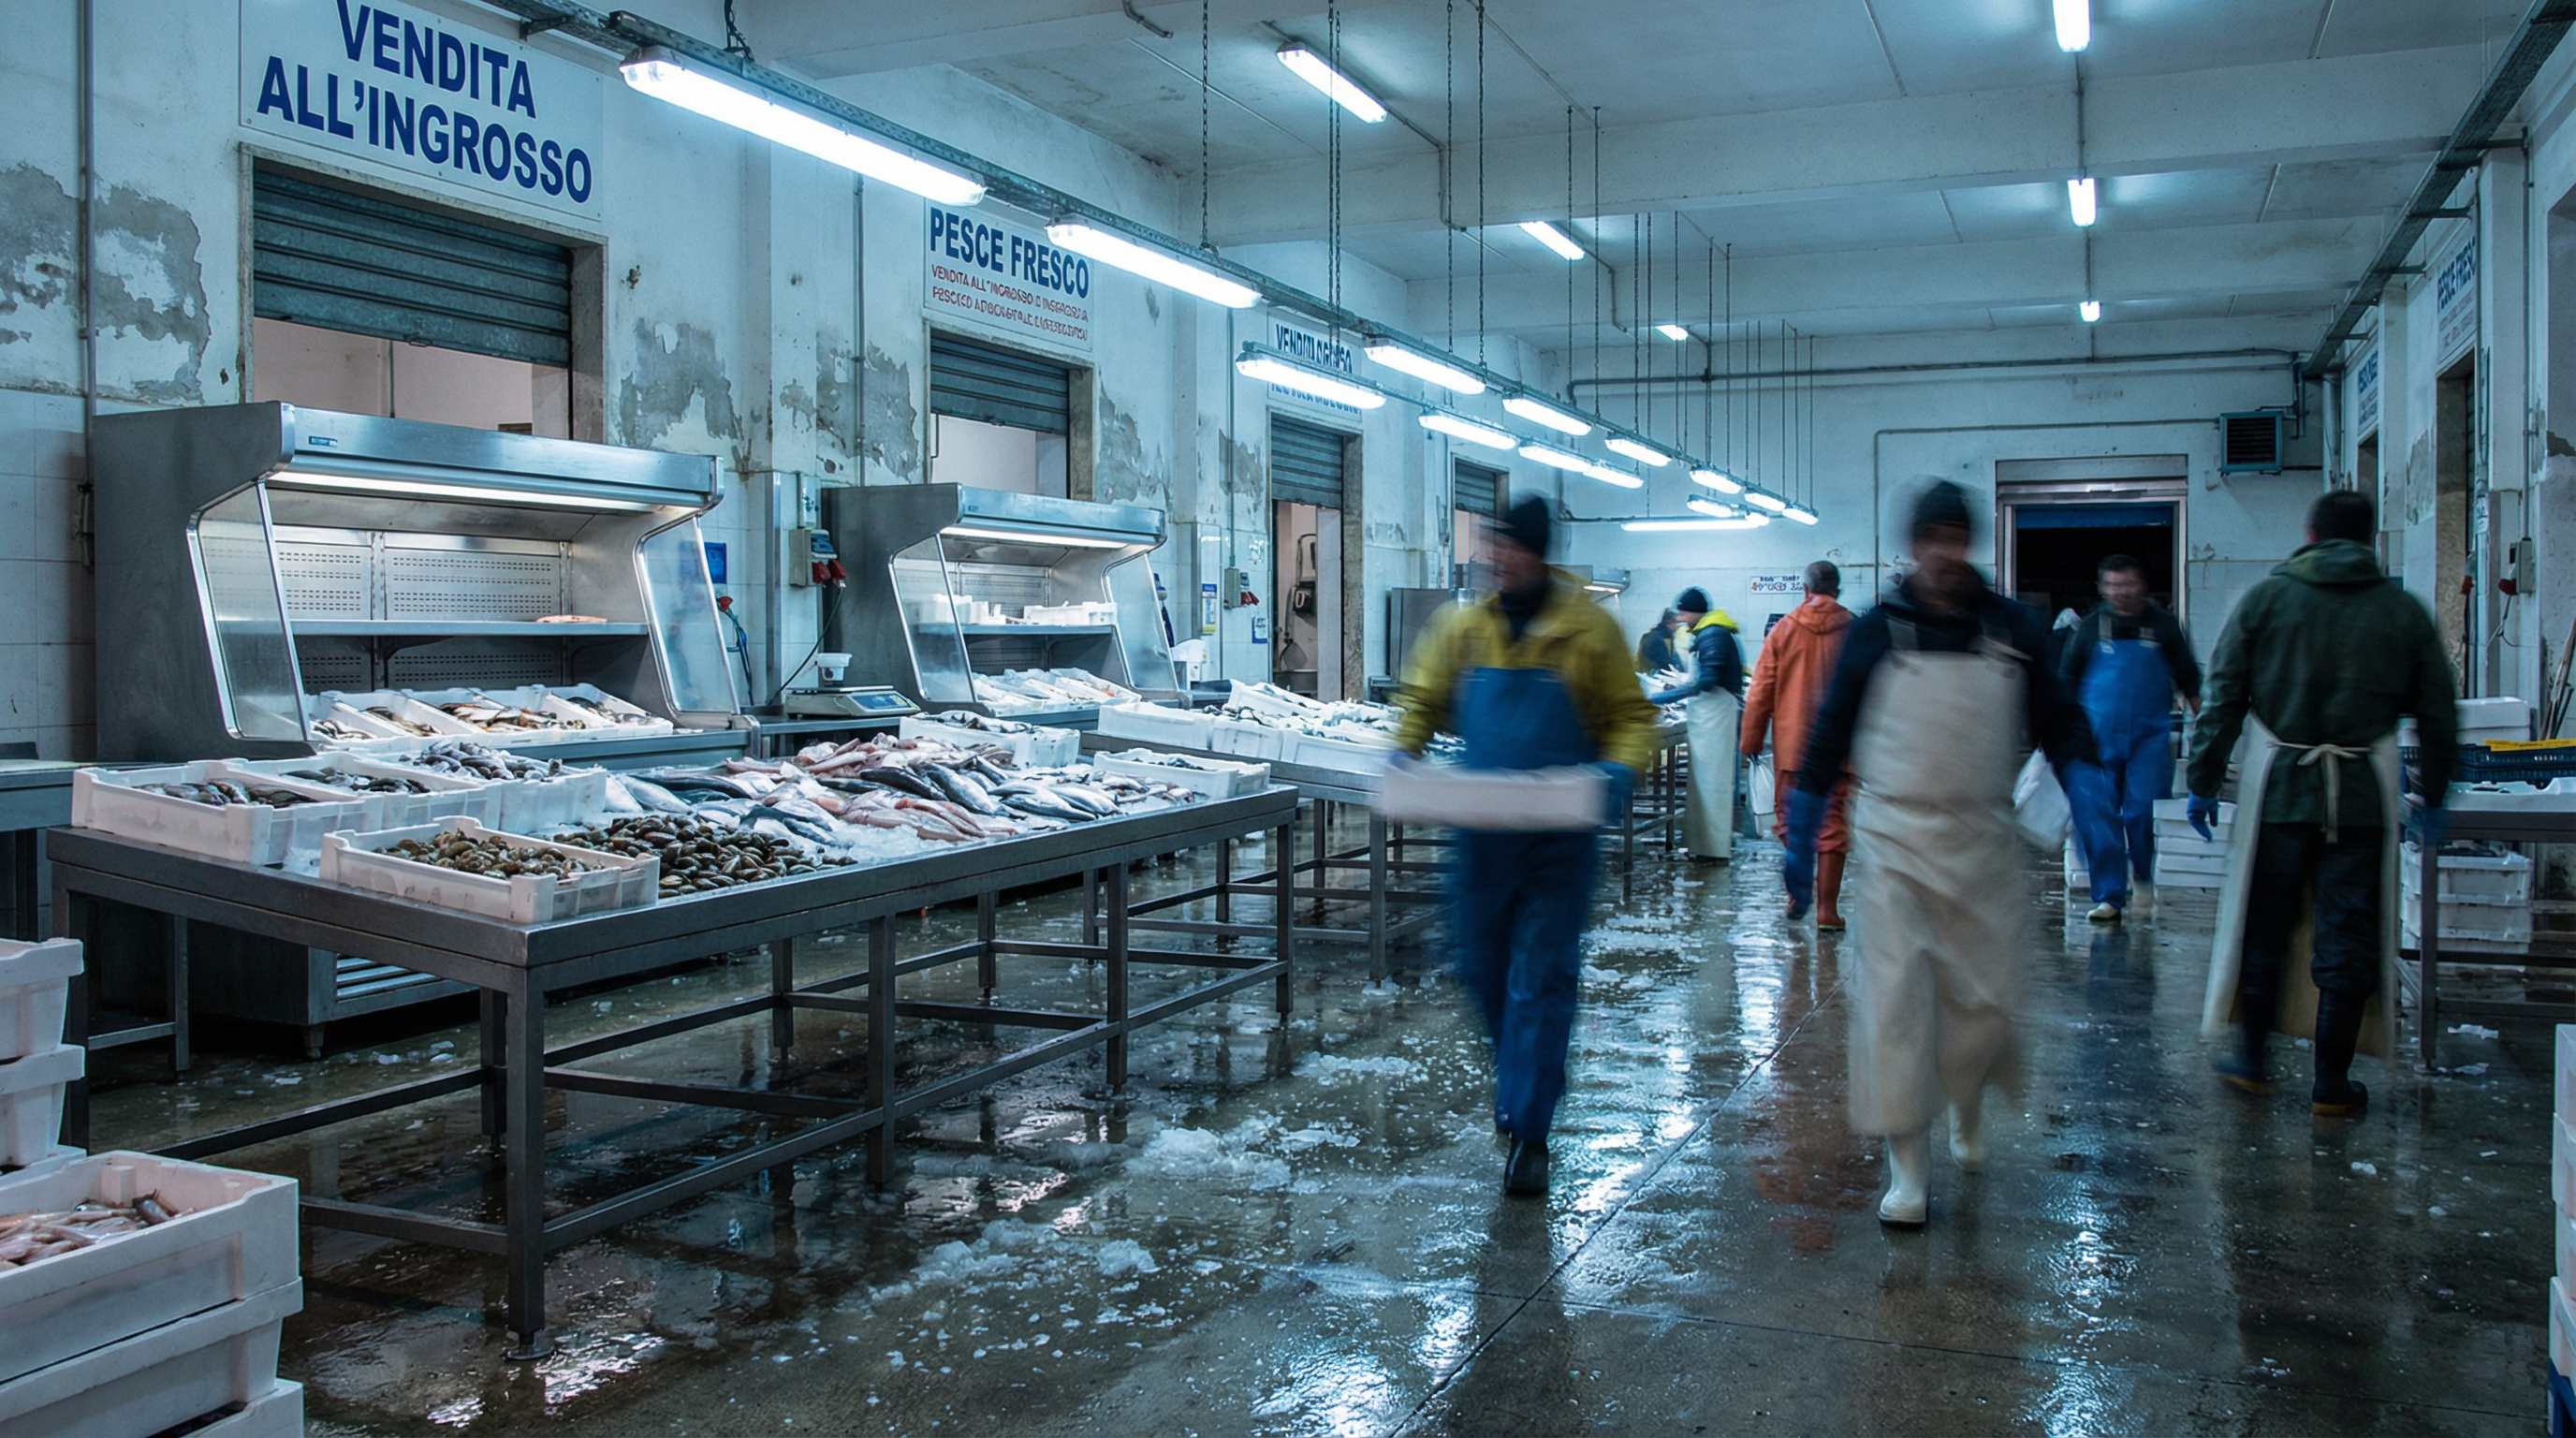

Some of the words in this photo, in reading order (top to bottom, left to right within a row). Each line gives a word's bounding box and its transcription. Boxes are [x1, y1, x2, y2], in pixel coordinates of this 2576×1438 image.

[337, 0, 537, 120] VENDITA
[256, 54, 593, 204] ALL'INGROSSO
[929, 206, 1003, 273] PESCE
[1011, 234, 1089, 299] FRESCO
